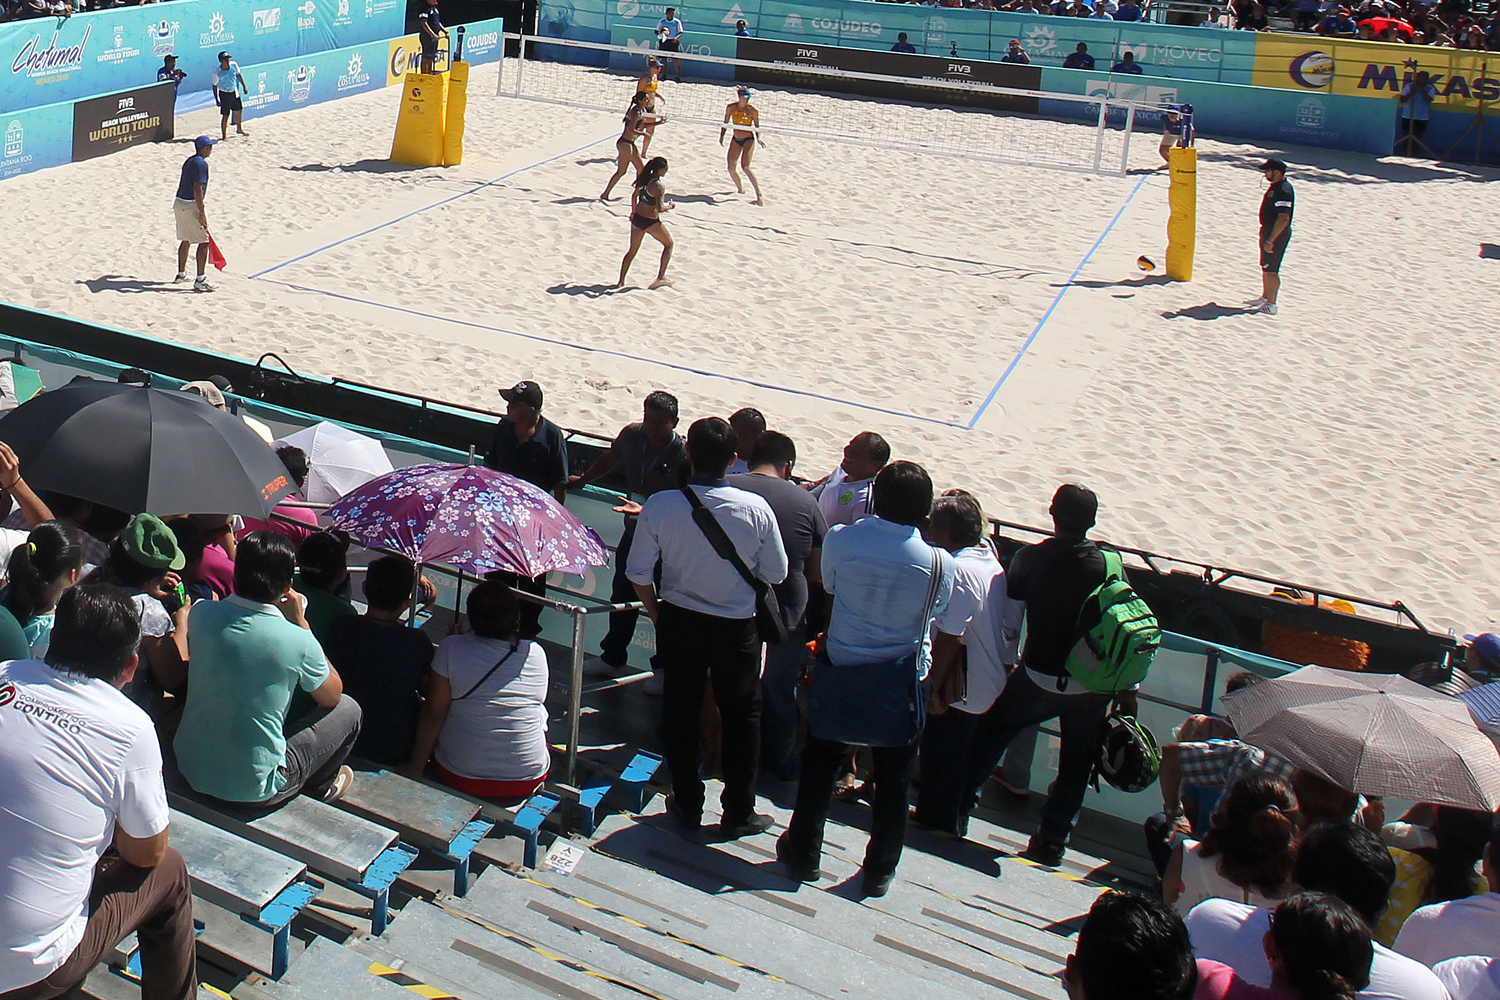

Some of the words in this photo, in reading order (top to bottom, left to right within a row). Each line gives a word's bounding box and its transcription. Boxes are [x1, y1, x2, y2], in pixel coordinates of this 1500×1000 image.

[811, 16, 883, 35] COJUDEQ
[466, 31, 498, 49] COJUDEQ
[11, 23, 92, 77] Chetumal
[96, 53, 122, 63] WORLD
[122, 49, 140, 58] TOUR
[1154, 43, 1224, 63] MOVEO
[118, 96, 135, 110] FIVB
[88, 123, 131, 143] WORLD
[131, 115, 161, 132] TOUR
[101, 119, 119, 129] BEACH
[118, 111, 150, 124] VOLLEYBALL
[20, 154, 33, 163] ROO
[13, 699, 82, 735] CONTIGO
[18, 693, 88, 727] COMPROMETIDO
